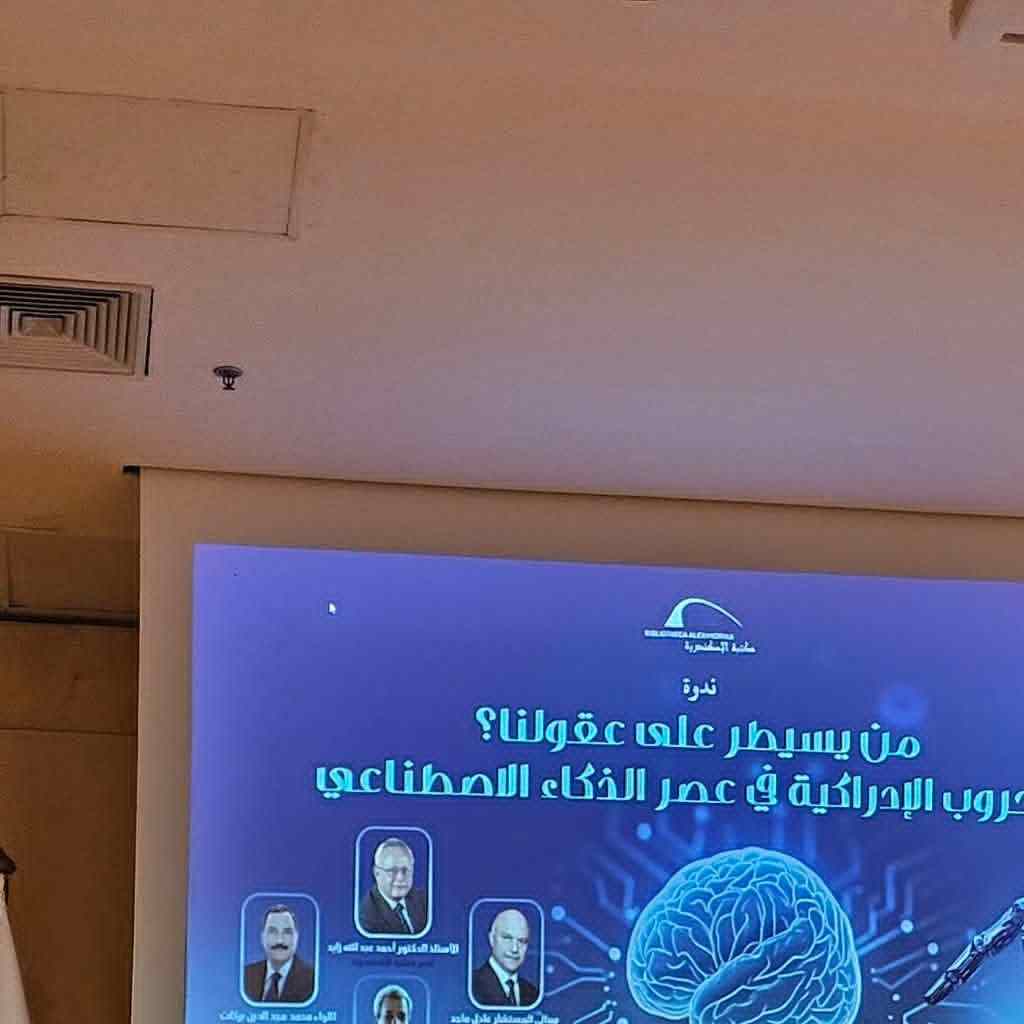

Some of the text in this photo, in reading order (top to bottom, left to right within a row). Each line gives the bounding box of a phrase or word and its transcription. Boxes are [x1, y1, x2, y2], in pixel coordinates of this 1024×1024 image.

[682, 678, 717, 701] ندوة
[475, 706, 921, 763] من يسيطر على عقولنا؟
[315, 759, 529, 799] الاصطناعي
[541, 762, 646, 801] الذكاء
[655, 779, 736, 811] عصر
[746, 763, 778, 812] في
[788, 771, 933, 820] الإدراكية
